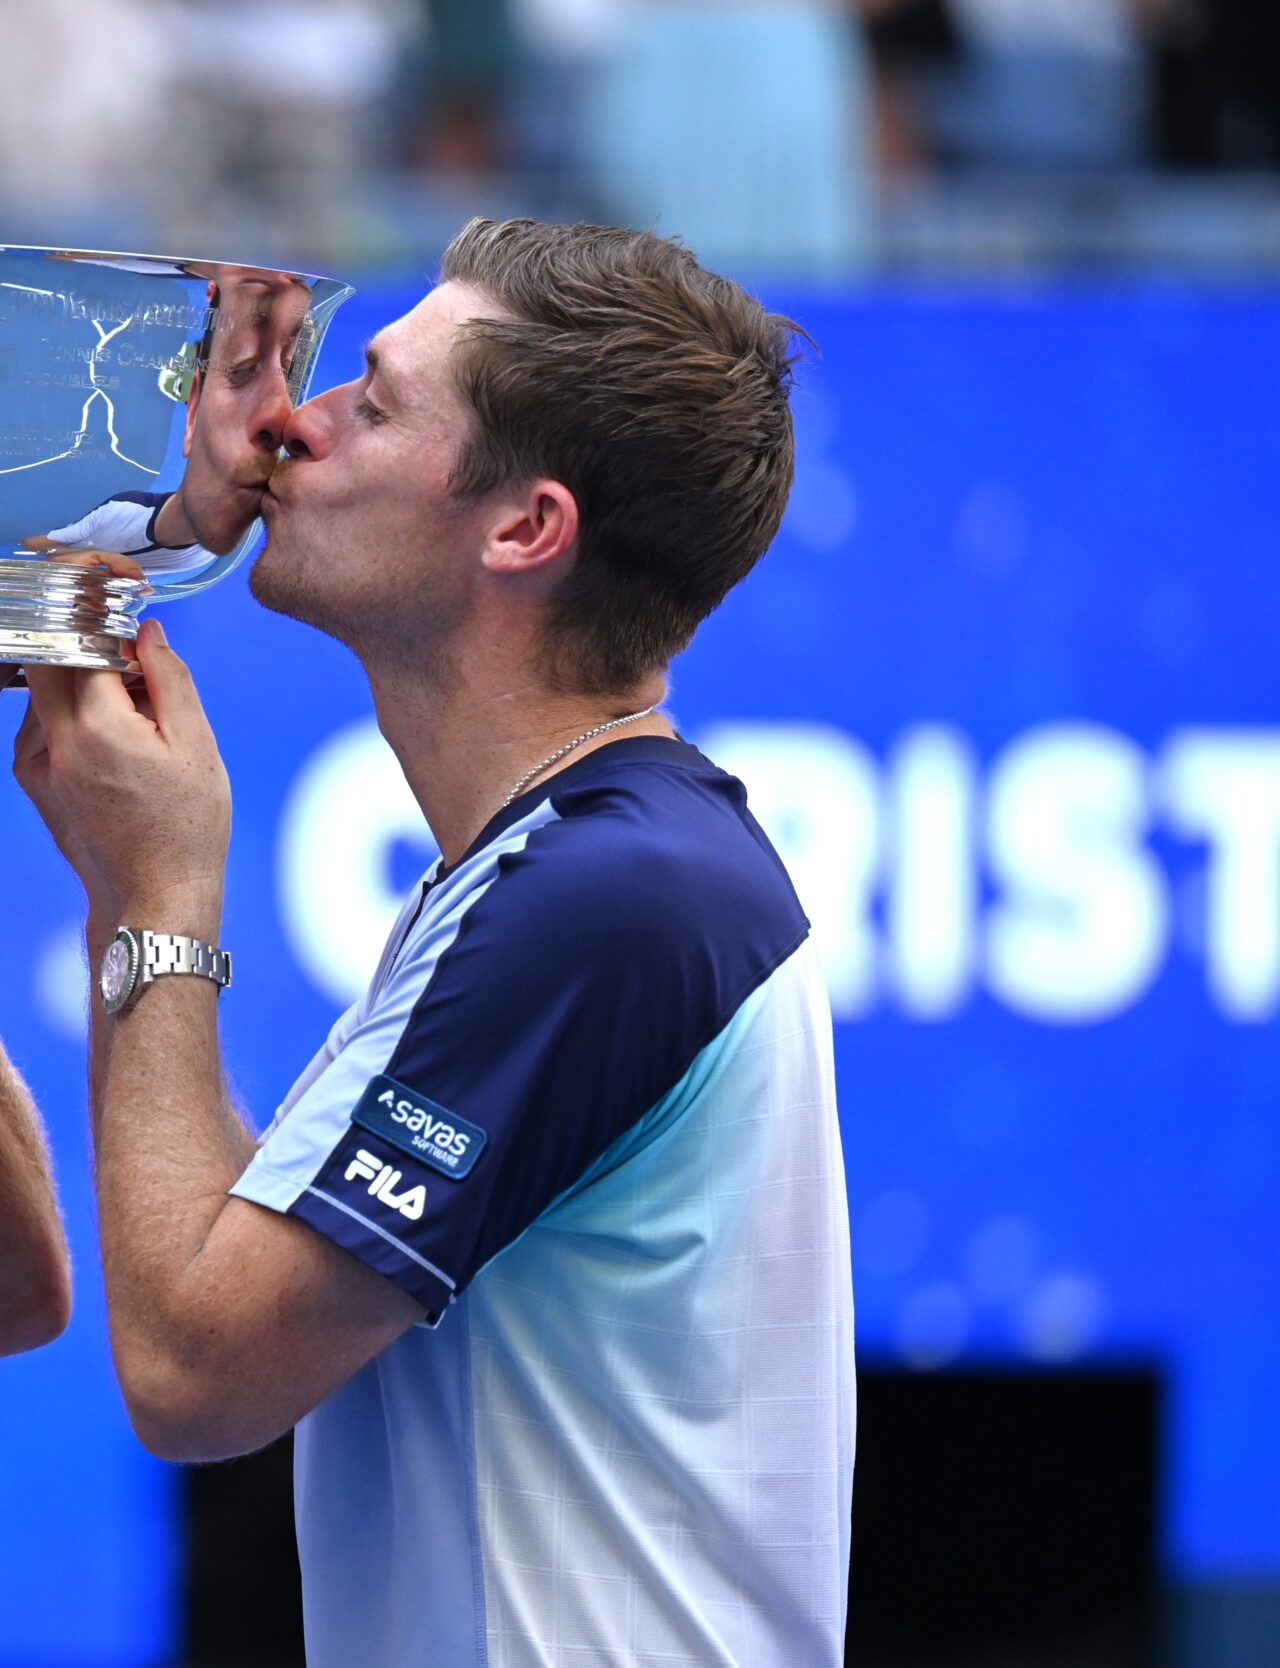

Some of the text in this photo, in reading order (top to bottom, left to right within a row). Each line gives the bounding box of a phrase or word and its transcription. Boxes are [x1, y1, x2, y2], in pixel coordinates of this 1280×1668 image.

[278, 718, 1280, 1024] CRIST
[344, 1148, 428, 1221] FILA
[411, 1135, 460, 1168] SOFTWARE
